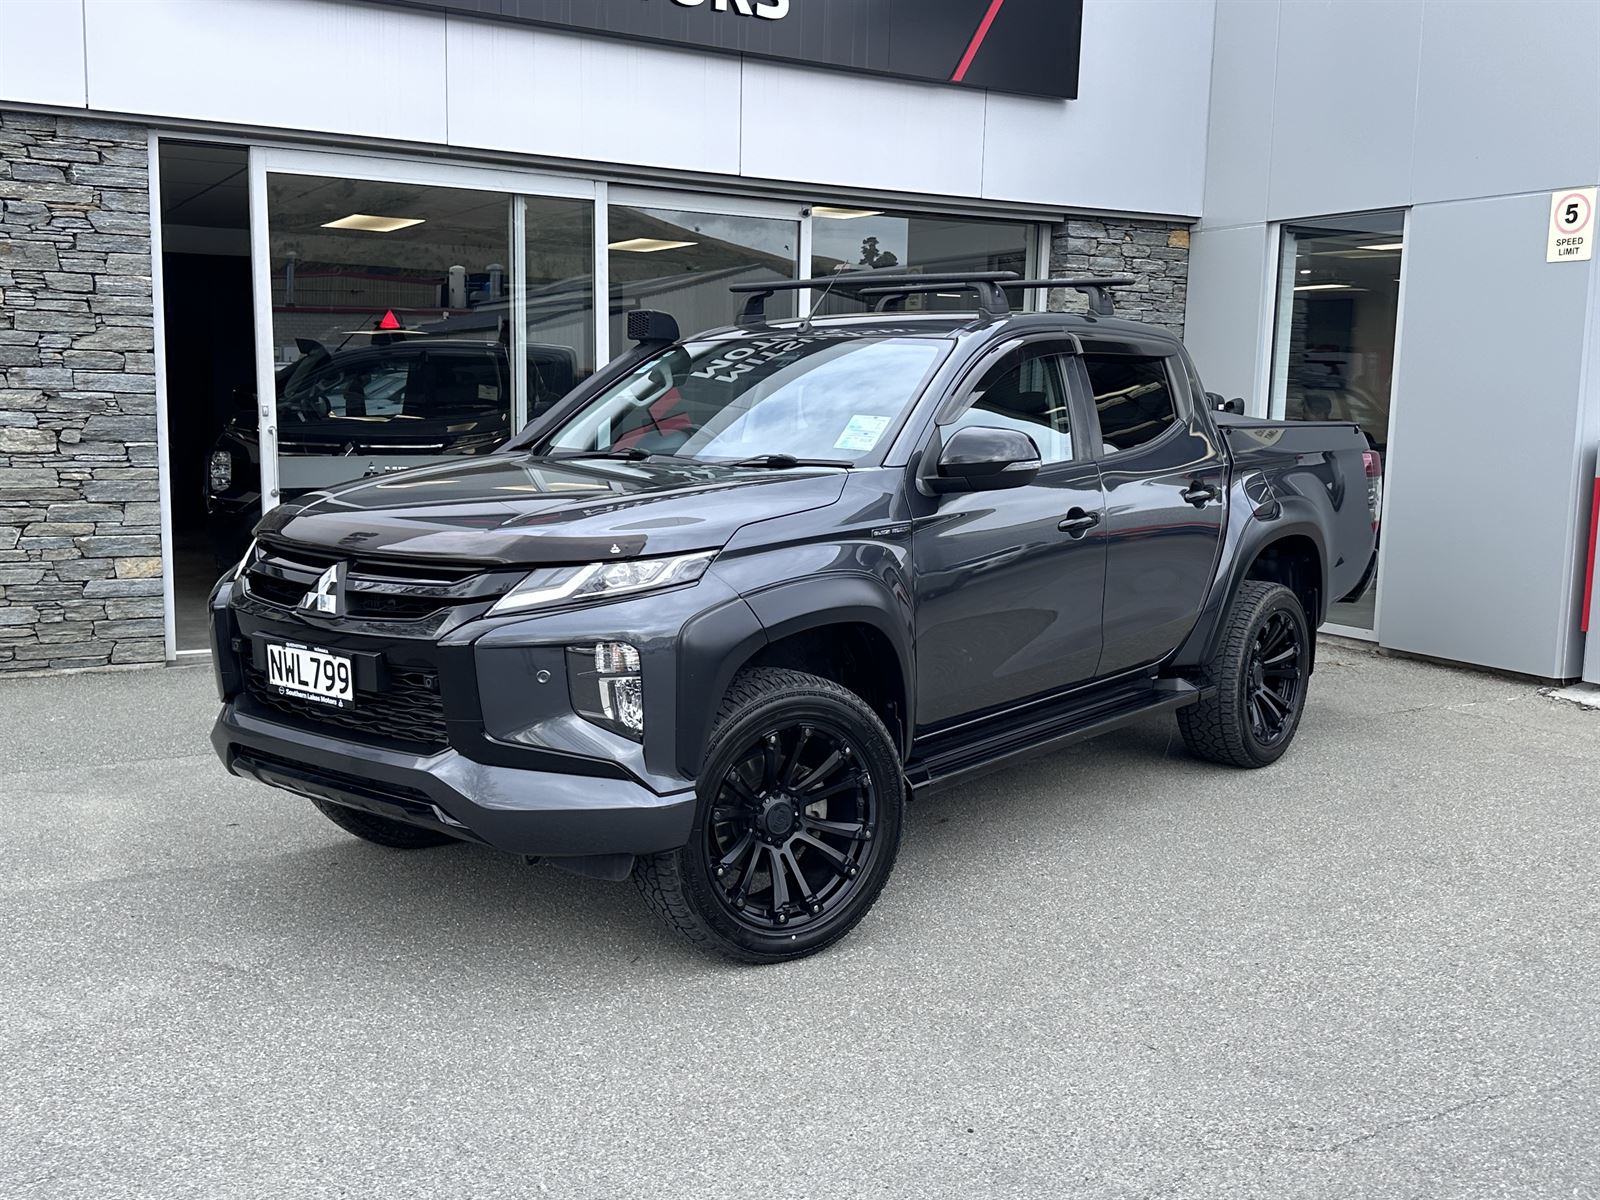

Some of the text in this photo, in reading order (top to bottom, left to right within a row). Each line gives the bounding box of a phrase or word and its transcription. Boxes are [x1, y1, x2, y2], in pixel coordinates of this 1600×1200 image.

[1565, 204, 1578, 224] 5
[1556, 237, 1583, 246] SPEED
[1559, 247, 1580, 256] LIMIT
[270, 648, 349, 695] NWL799
